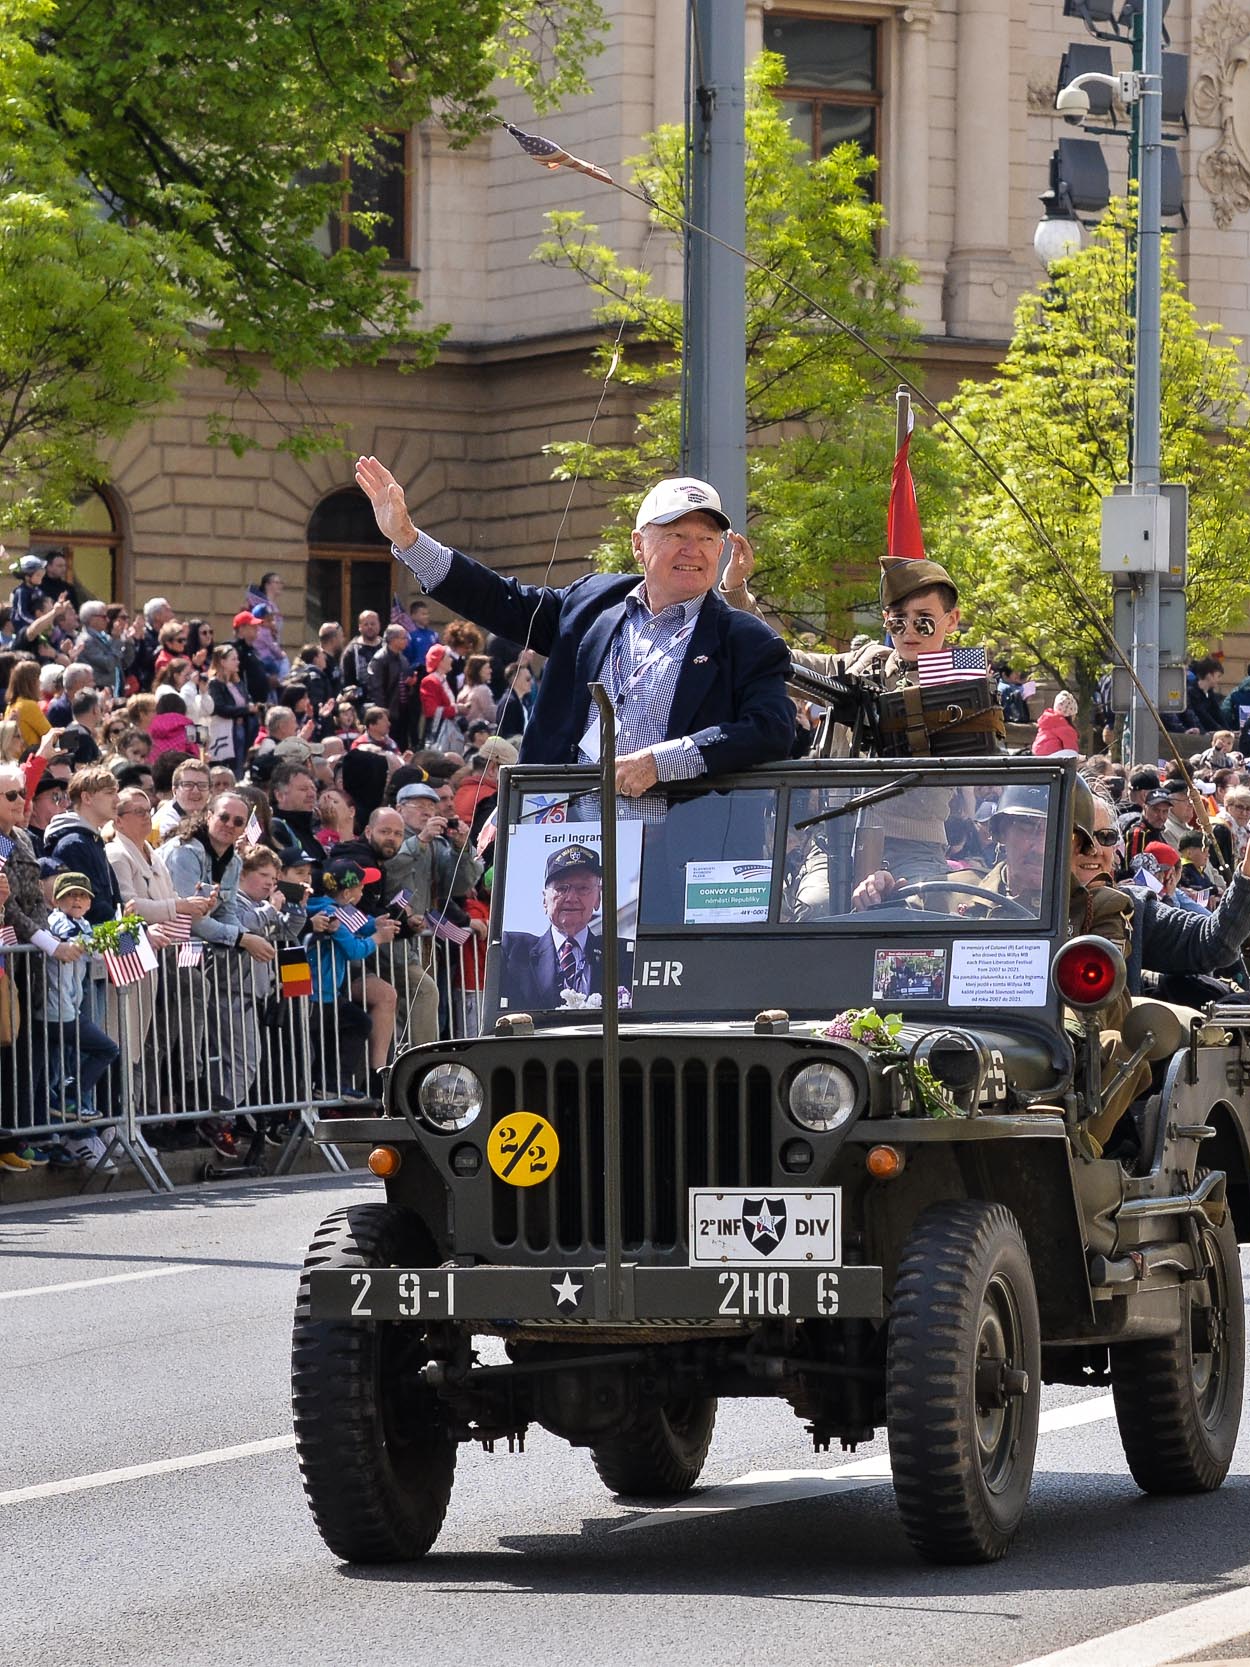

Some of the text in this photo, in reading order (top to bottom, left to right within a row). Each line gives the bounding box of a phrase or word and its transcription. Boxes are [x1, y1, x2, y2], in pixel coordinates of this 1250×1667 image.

[544, 833, 566, 844] Earl
[699, 887, 728, 895] CONVOY
[731, 896, 760, 904] Republiky
[717, 1218, 742, 1236] INF
[795, 1219, 830, 1236] DIV
[350, 1273, 372, 1316] 2
[718, 1272, 839, 1316] 2HQ 6
